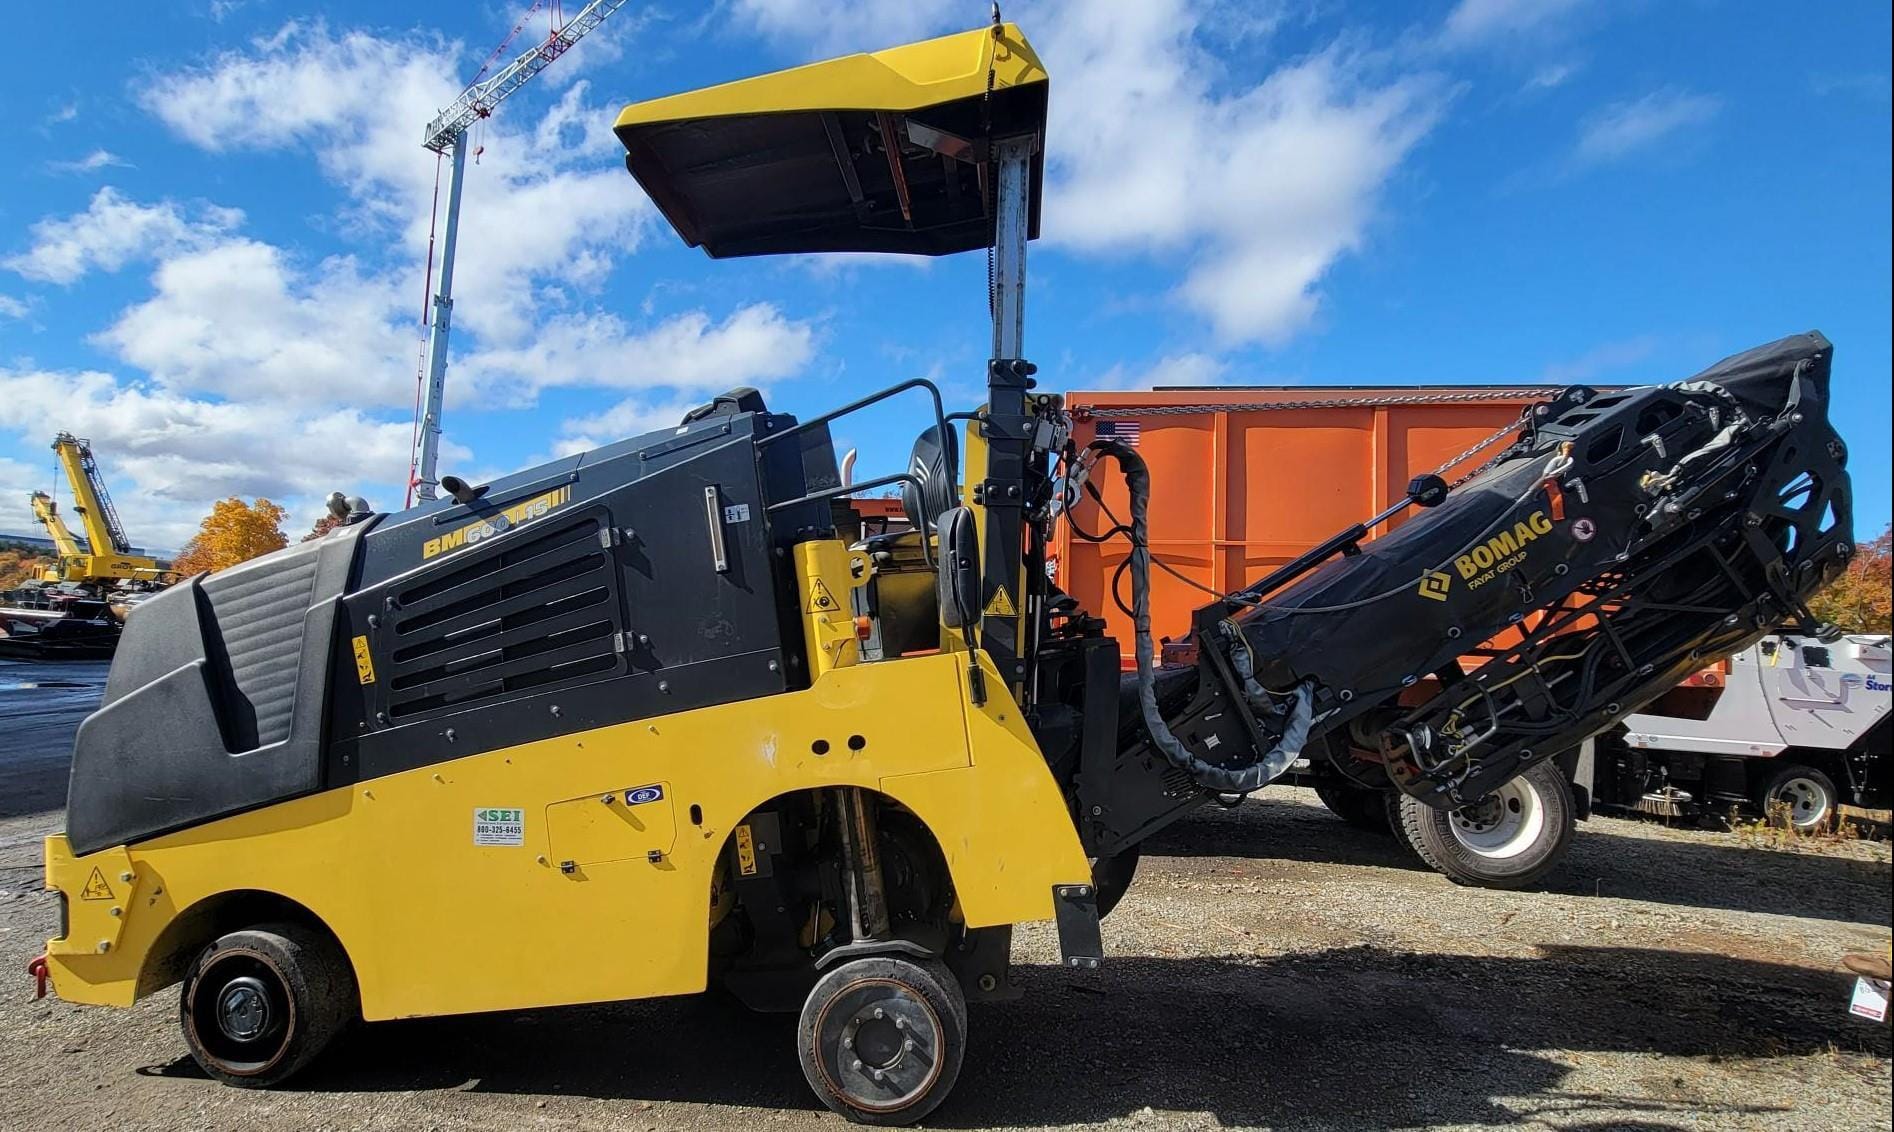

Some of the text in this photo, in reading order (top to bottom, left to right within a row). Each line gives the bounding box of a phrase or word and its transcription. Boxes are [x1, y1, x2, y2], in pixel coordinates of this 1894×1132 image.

[1454, 510, 1553, 580] BOMAG
[1467, 551, 1527, 591] FAYAT GROUP
[1865, 680, 1892, 692] Stor
[489, 810, 521, 822] SEI
